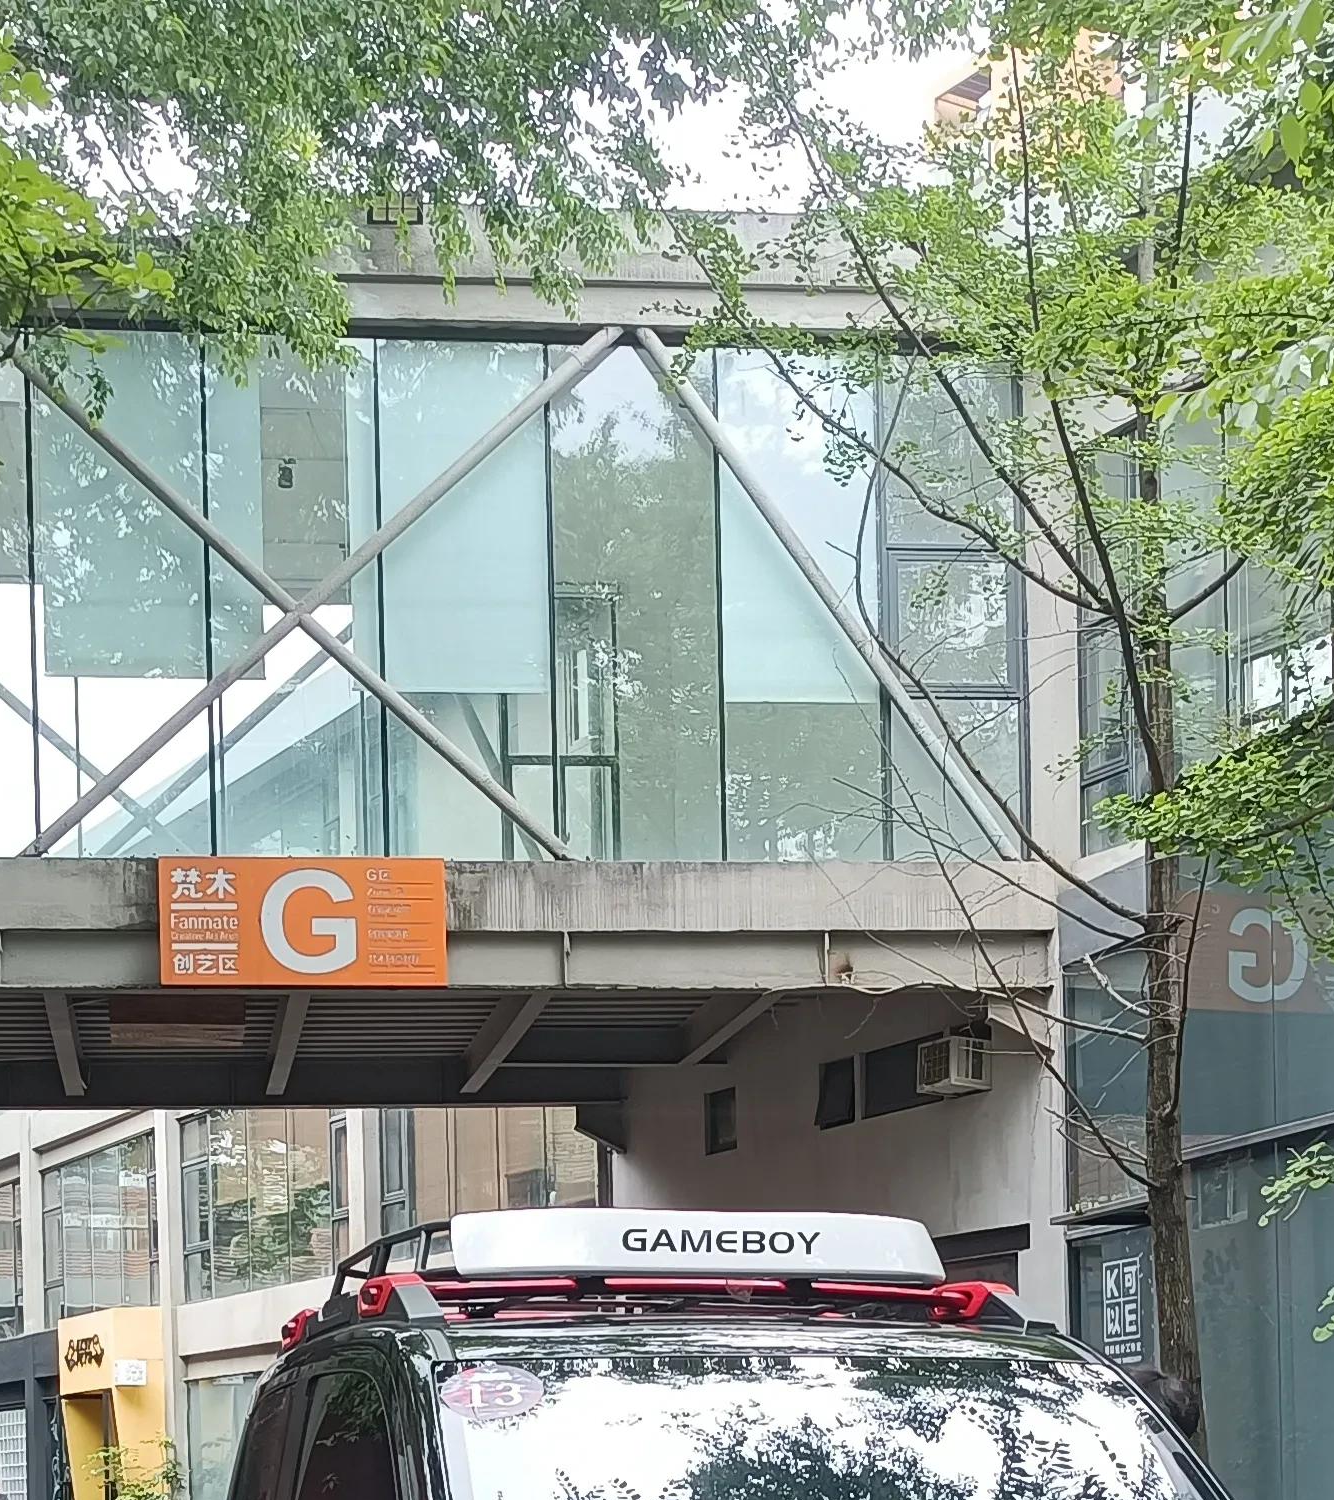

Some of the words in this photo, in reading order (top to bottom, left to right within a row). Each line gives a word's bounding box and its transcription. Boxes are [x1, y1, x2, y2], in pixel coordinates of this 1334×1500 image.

[170, 867, 236, 899] 梵木
[170, 912, 238, 930] Fanmate
[261, 867, 357, 974] G
[173, 953, 238, 974] 创艺区
[622, 1228, 820, 1255] GAMEBOY
